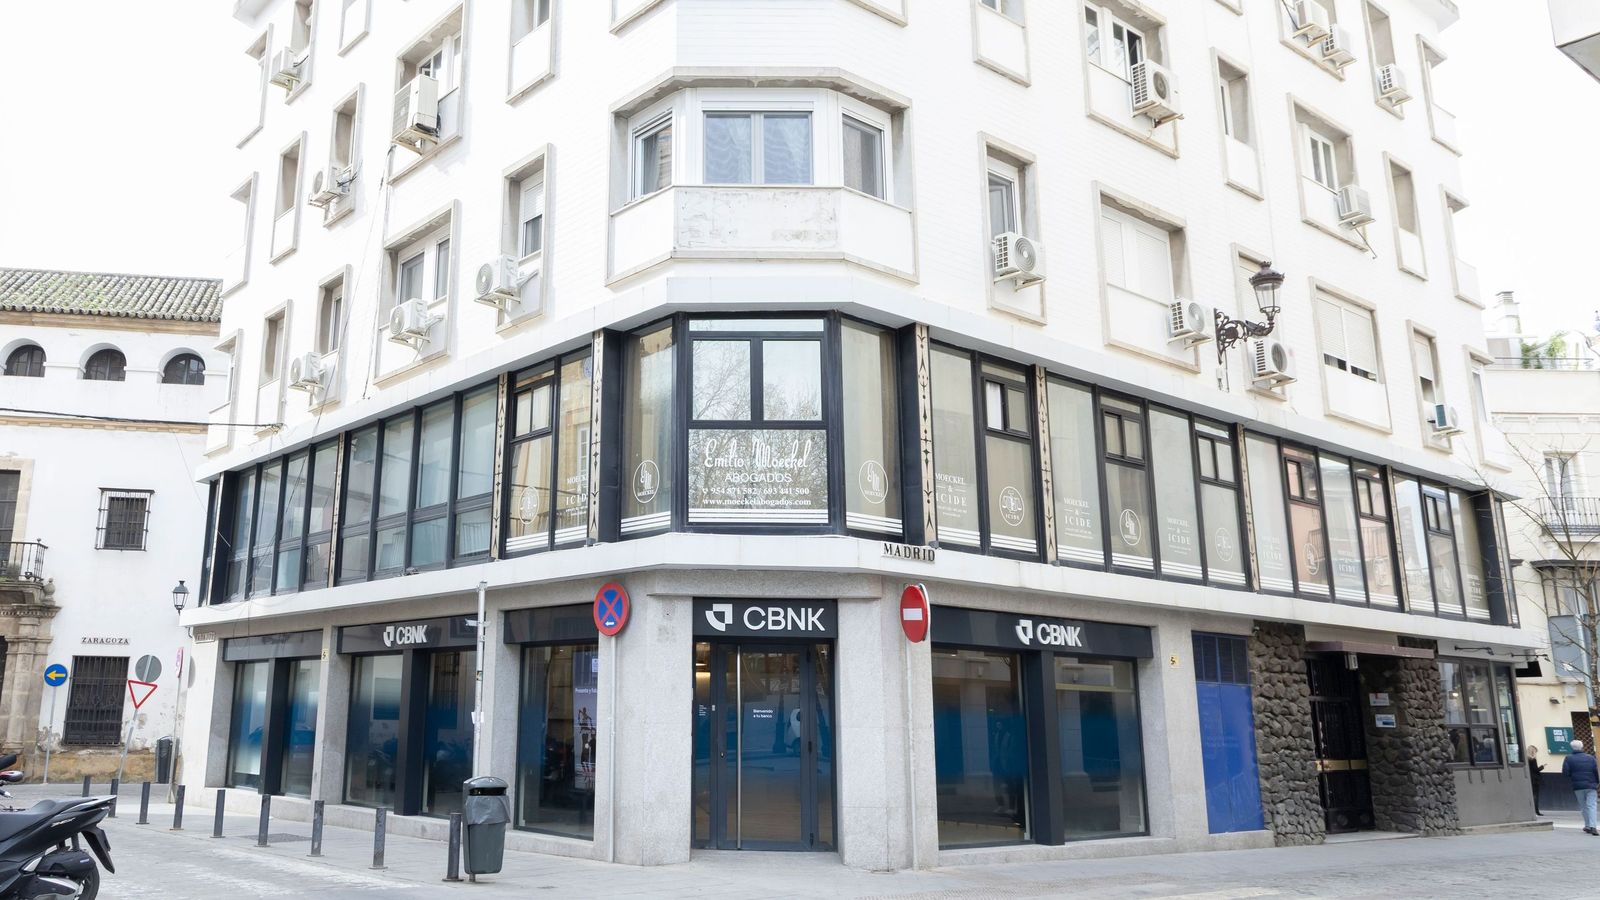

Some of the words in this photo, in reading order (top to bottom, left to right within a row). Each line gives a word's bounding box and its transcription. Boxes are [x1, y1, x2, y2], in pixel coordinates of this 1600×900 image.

[704, 438, 744, 468] Emilio
[752, 438, 812, 471] Moeckel
[724, 472, 793, 483] ABOGADOS
[935, 473, 966, 485] MOECKEL
[711, 487, 726, 495] 954
[763, 487, 778, 495] 693
[795, 487, 810, 495] 500
[702, 499, 811, 507] www.moeckelabogados.com
[936, 494, 968, 507] ICIDE
[1064, 515, 1092, 528] ICIDE
[1168, 533, 1191, 545] ICIDE
[884, 543, 935, 561] MADRID
[743, 606, 826, 631] CBNK
[81, 637, 129, 645] ZARAGOZA
[396, 625, 428, 645] CBNK
[1036, 623, 1082, 647] CBNK
